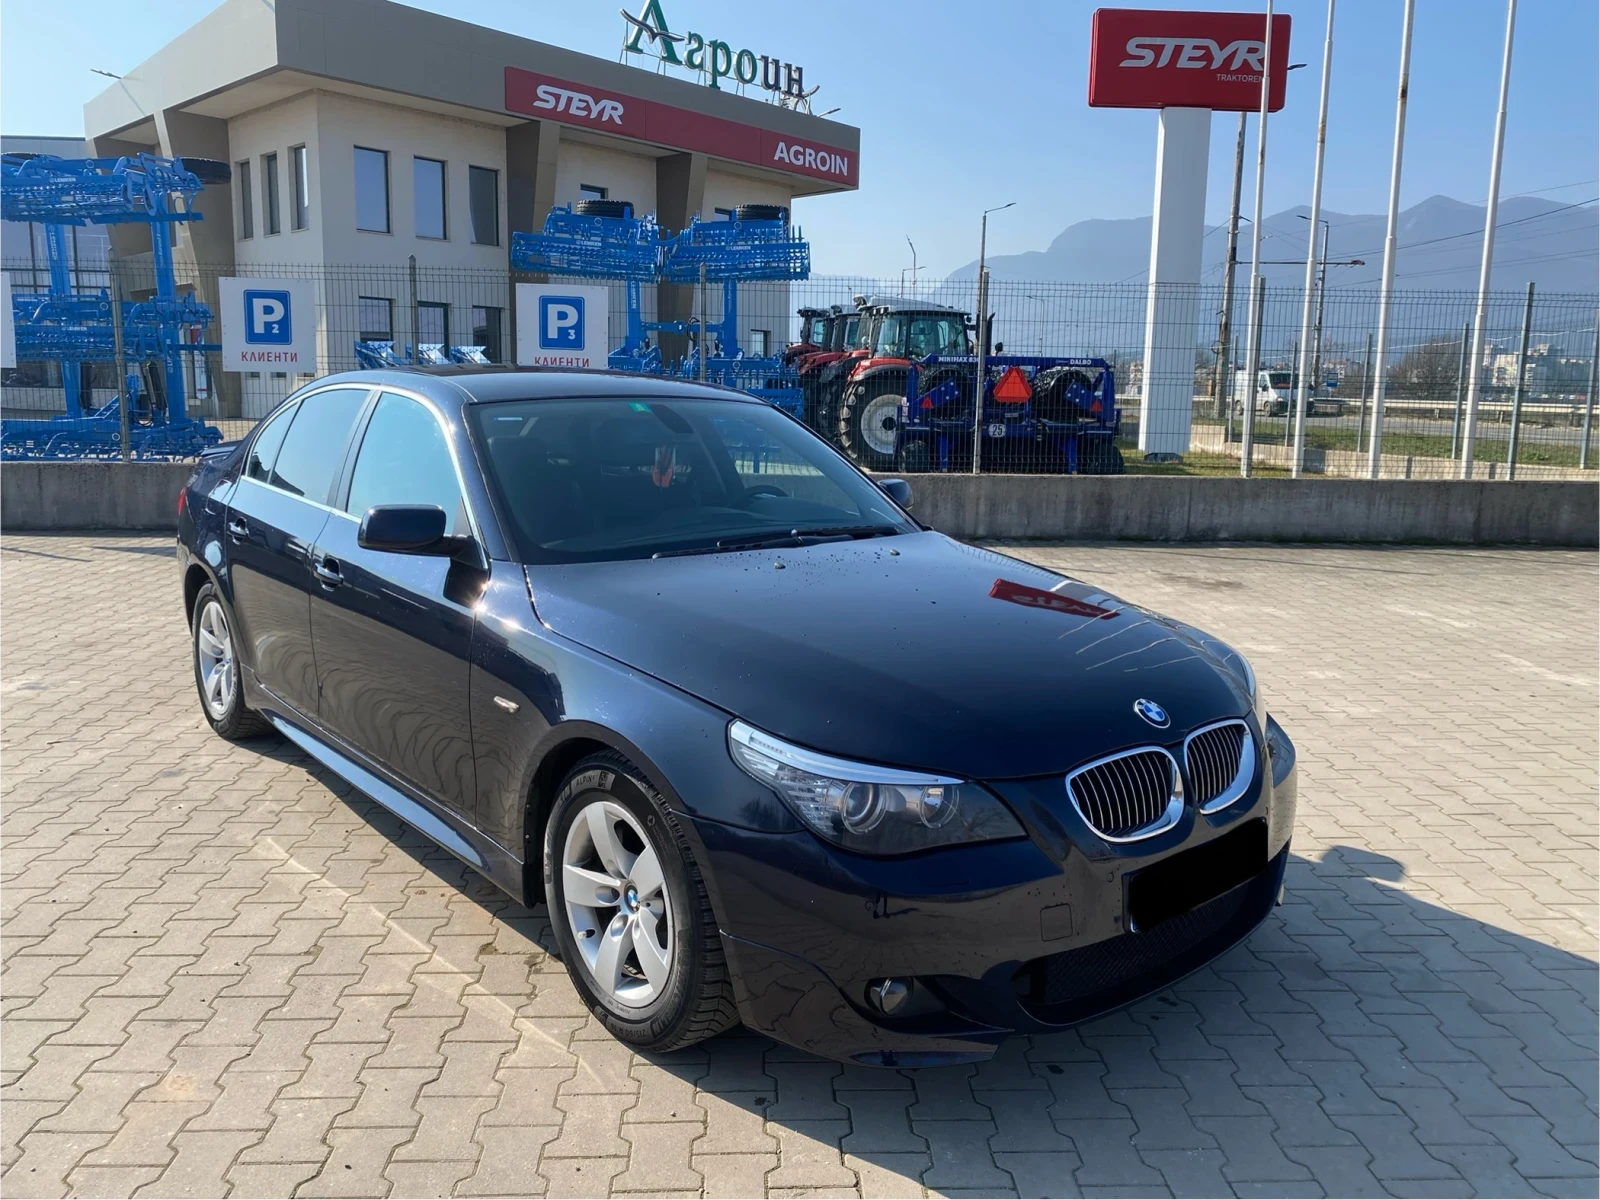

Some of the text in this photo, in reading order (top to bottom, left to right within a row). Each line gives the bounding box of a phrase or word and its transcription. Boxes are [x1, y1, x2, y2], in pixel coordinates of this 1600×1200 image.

[1118, 36, 1265, 71] STEYR
[532, 84, 624, 125] STEYR
[773, 141, 848, 176] AGROIN
[241, 351, 298, 363] КЛИЕНТИ
[534, 356, 590, 368] КЛИЕНТИ
[992, 424, 1003, 435] 25
